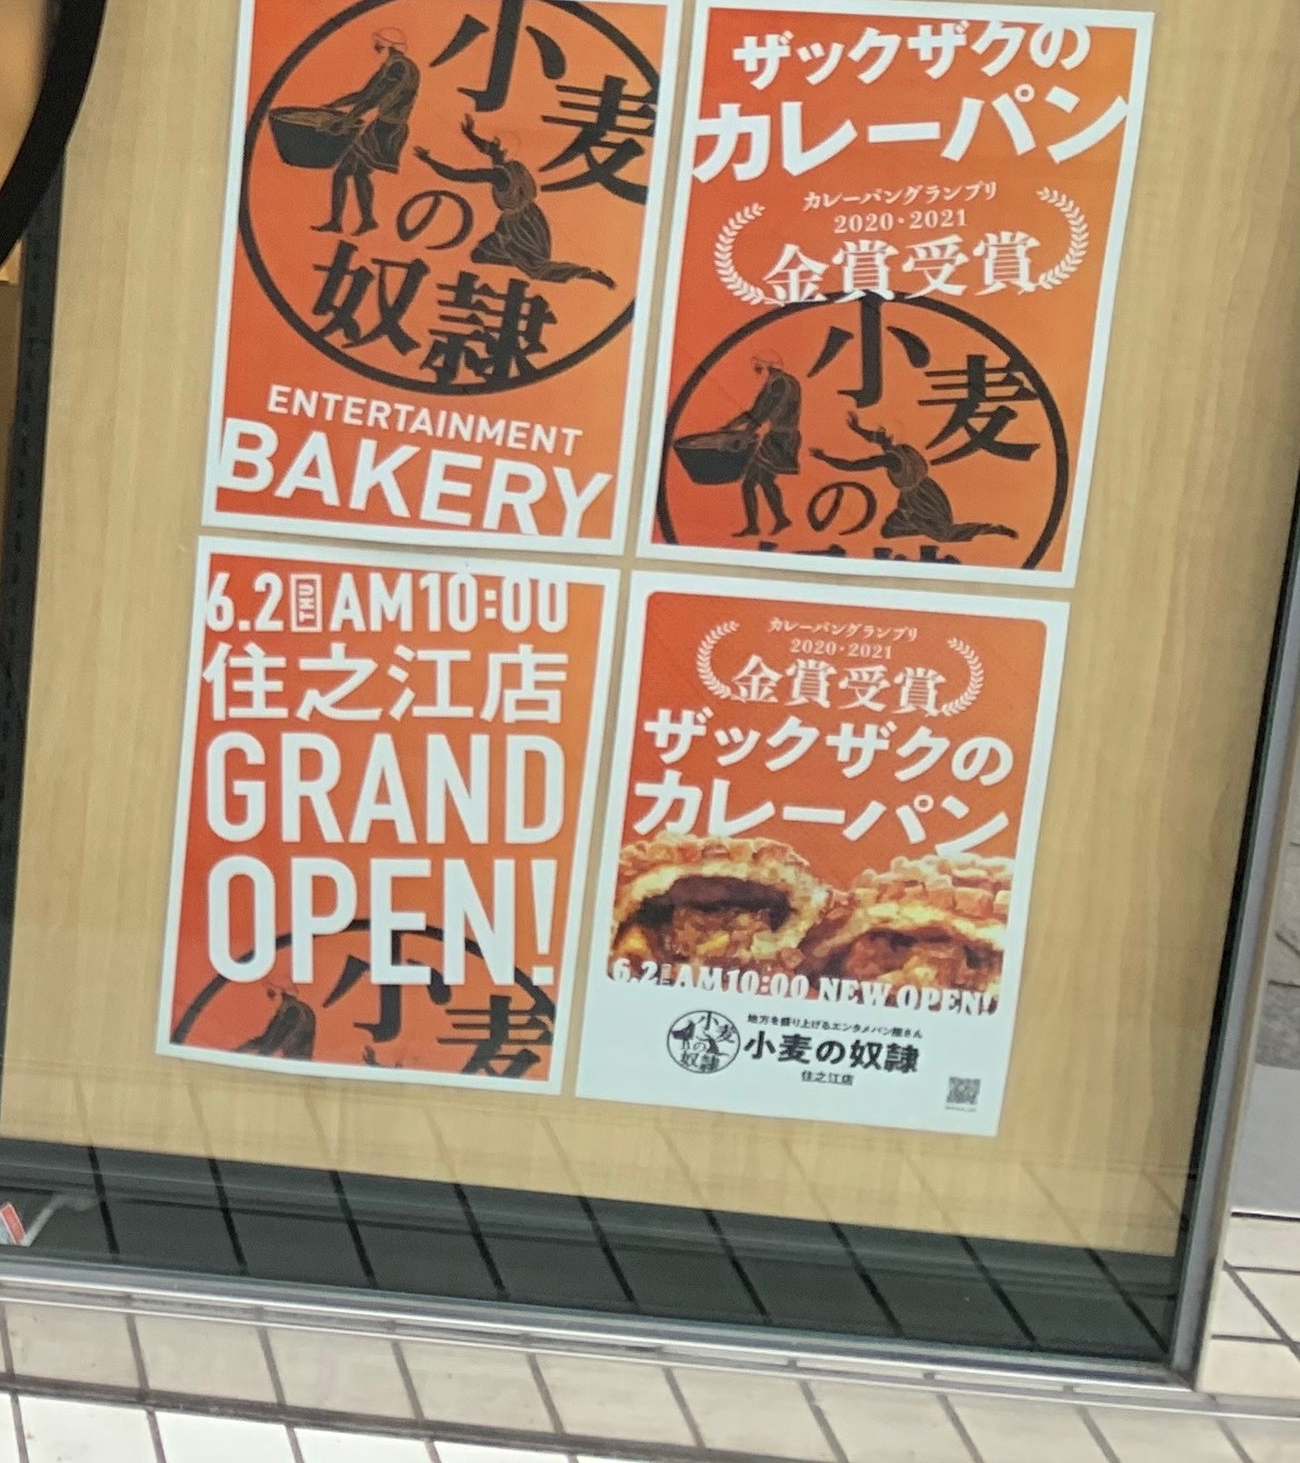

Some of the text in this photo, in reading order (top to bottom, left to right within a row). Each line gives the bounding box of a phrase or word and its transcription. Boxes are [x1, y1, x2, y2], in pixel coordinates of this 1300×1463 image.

[734, 21, 1090, 90] ザックザクの
[430, 0, 657, 206] 小麦
[692, 84, 1127, 182] カレーパン
[396, 190, 472, 250] の
[802, 181, 998, 212] カレーパングランプリ
[763, 231, 1041, 305] 金賞受賞
[312, 240, 557, 385] 奴隷
[807, 293, 1040, 468] 小麦
[268, 385, 583, 456] ENTERTAINMENT
[218, 417, 614, 537] BAKERY
[806, 481, 877, 534] の
[205, 572, 284, 632] 6.2
[330, 573, 567, 633] AM10:00
[767, 617, 919, 642] カレーパングランプリ
[203, 642, 568, 723] 住之江店
[733, 654, 947, 717] 金賞受賞
[643, 707, 1013, 786] ザックザクの
[205, 731, 565, 844] GRAND
[634, 771, 1009, 857] カレーパン
[207, 856, 557, 986] OPEN!
[819, 978, 891, 1008] NEW
[896, 986, 999, 1015] OPEN!
[744, 1030, 919, 1074] 小麦の奴隷
[801, 1071, 854, 1086] 住之江店
